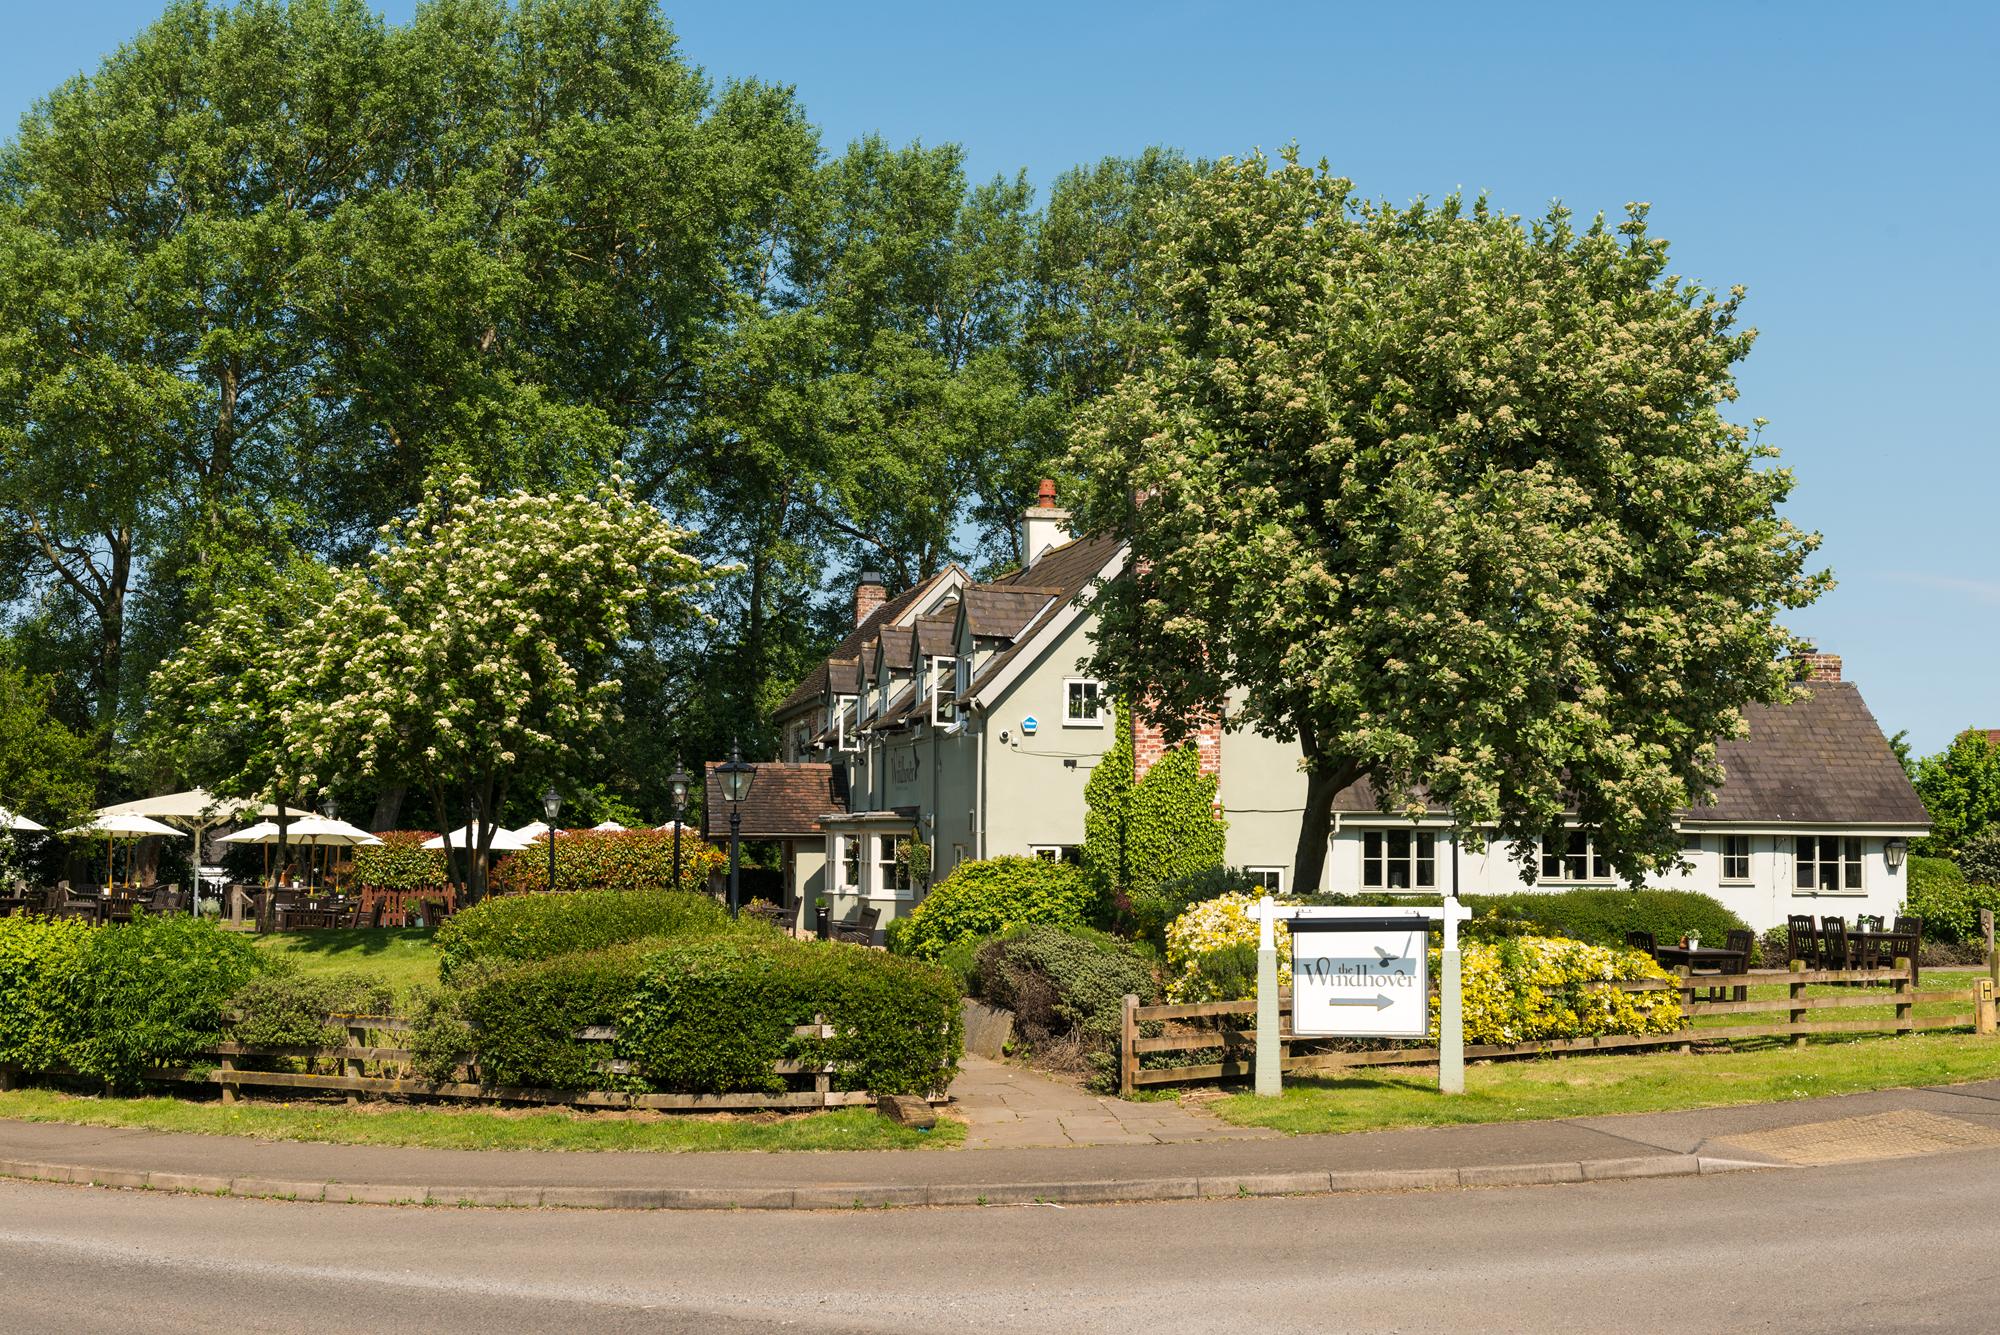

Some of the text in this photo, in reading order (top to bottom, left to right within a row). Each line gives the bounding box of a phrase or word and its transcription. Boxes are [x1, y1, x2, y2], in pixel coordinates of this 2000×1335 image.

[1303, 957, 1416, 987] Windhover
[1338, 963, 1353, 974] the
[1983, 982, 1992, 999] H
